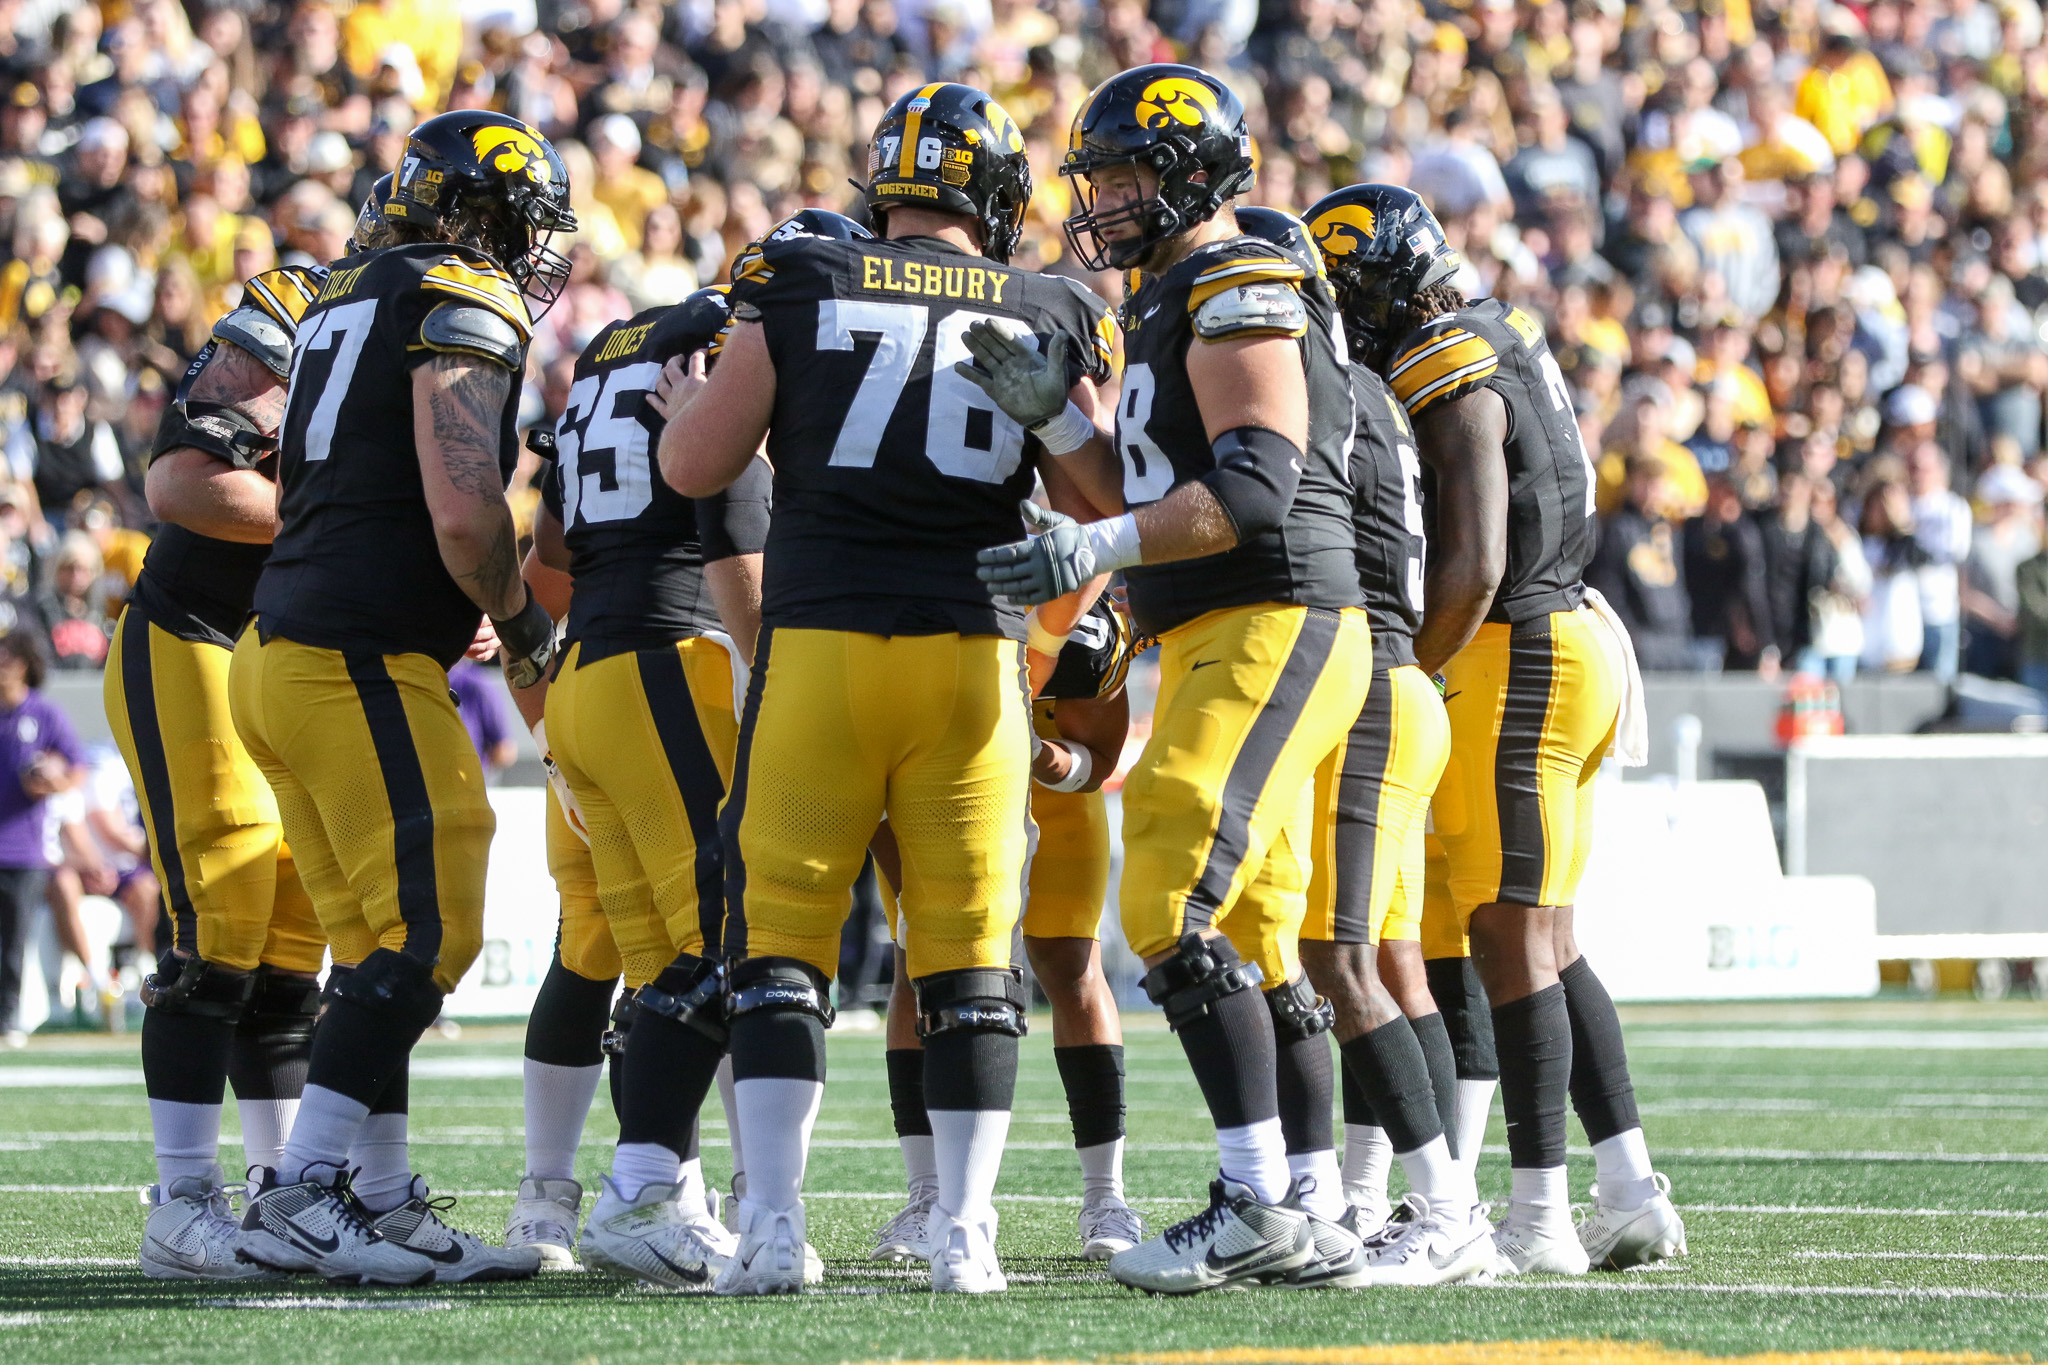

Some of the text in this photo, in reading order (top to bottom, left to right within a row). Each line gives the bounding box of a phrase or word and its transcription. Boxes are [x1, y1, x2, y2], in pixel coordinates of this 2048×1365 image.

[876, 183, 938, 199] TOGETHER
[318, 262, 371, 304] COLBY
[862, 256, 1009, 304] ELSBURY
[594, 321, 657, 363] JONES
[816, 299, 1040, 485] 76
[765, 991, 815, 1001] DONJO
[959, 1011, 1010, 1021] DONJOY
[259, 1216, 292, 1244] FORCE
